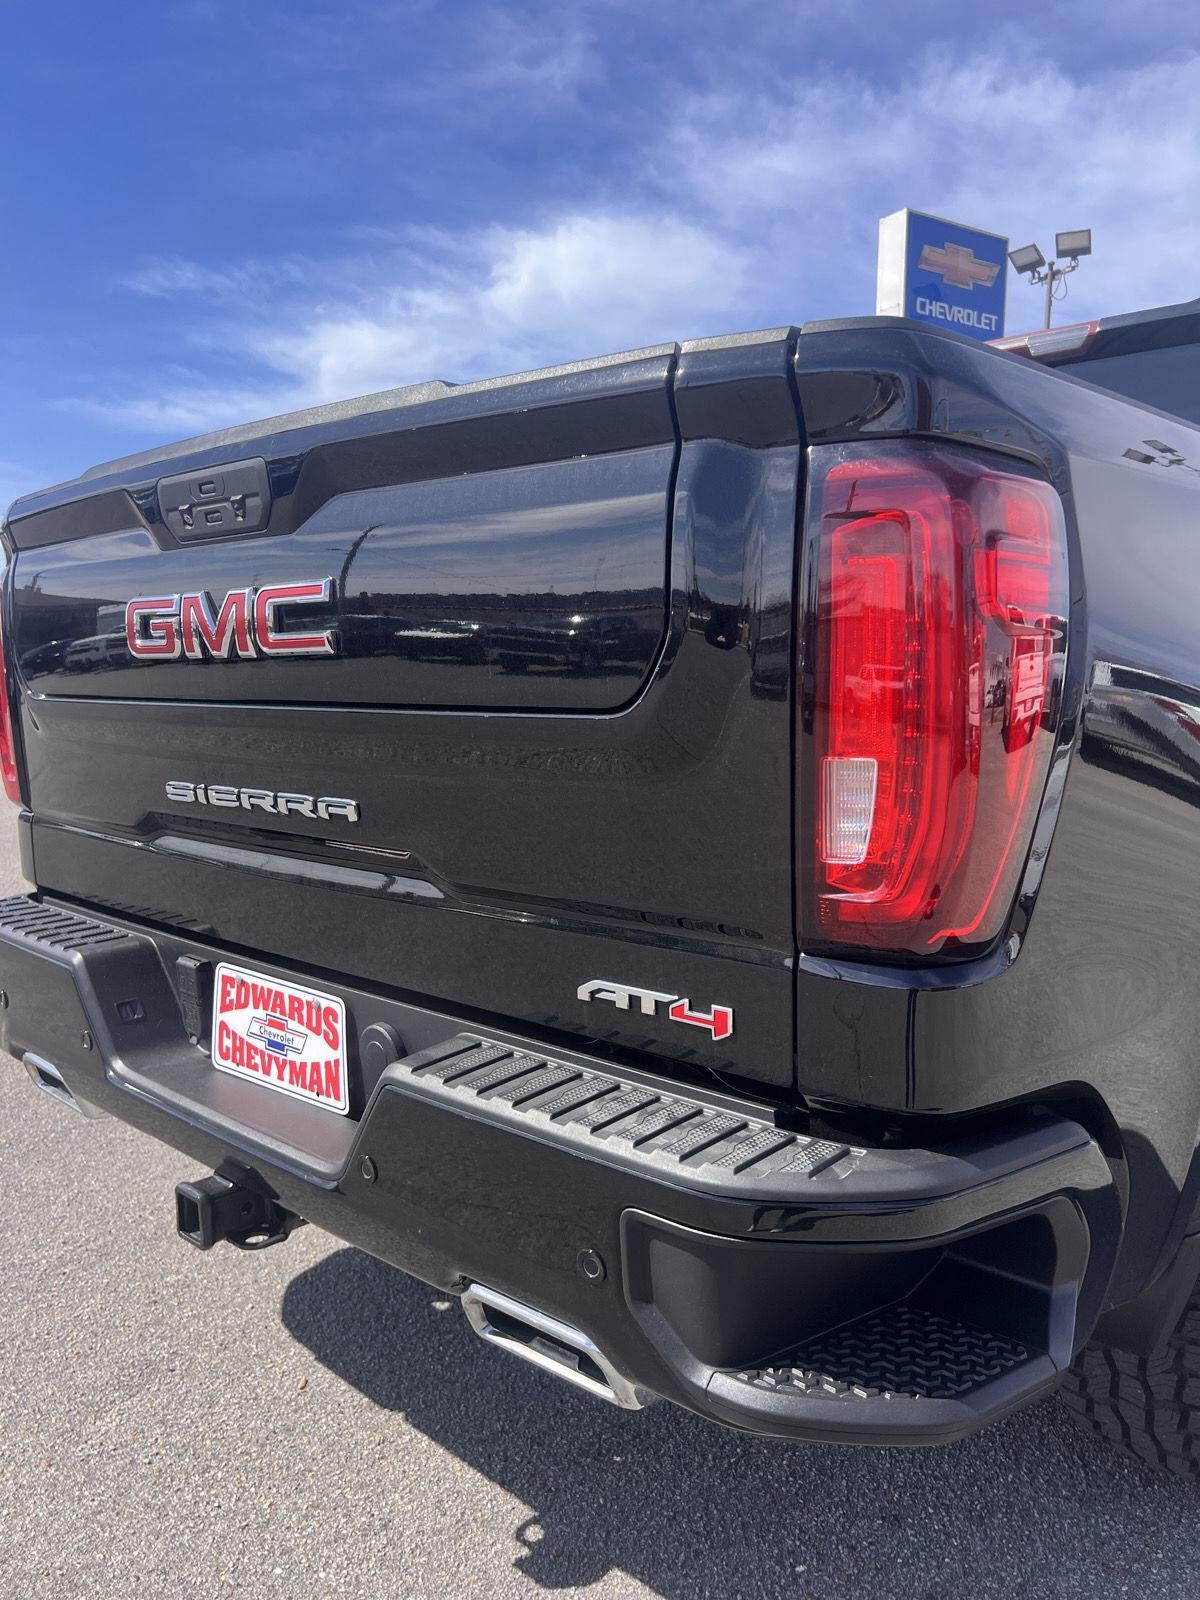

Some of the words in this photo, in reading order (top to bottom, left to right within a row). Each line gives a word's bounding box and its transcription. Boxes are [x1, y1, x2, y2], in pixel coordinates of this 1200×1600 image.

[915, 297, 999, 332] CHEVROLET
[126, 576, 338, 660] GMC
[165, 780, 361, 823] SIERRA
[219, 974, 339, 1052] EDWARDS
[258, 1025, 295, 1046] Chevrolet
[577, 979, 733, 1041] AT4
[217, 1019, 342, 1102] CHEVYMAN
